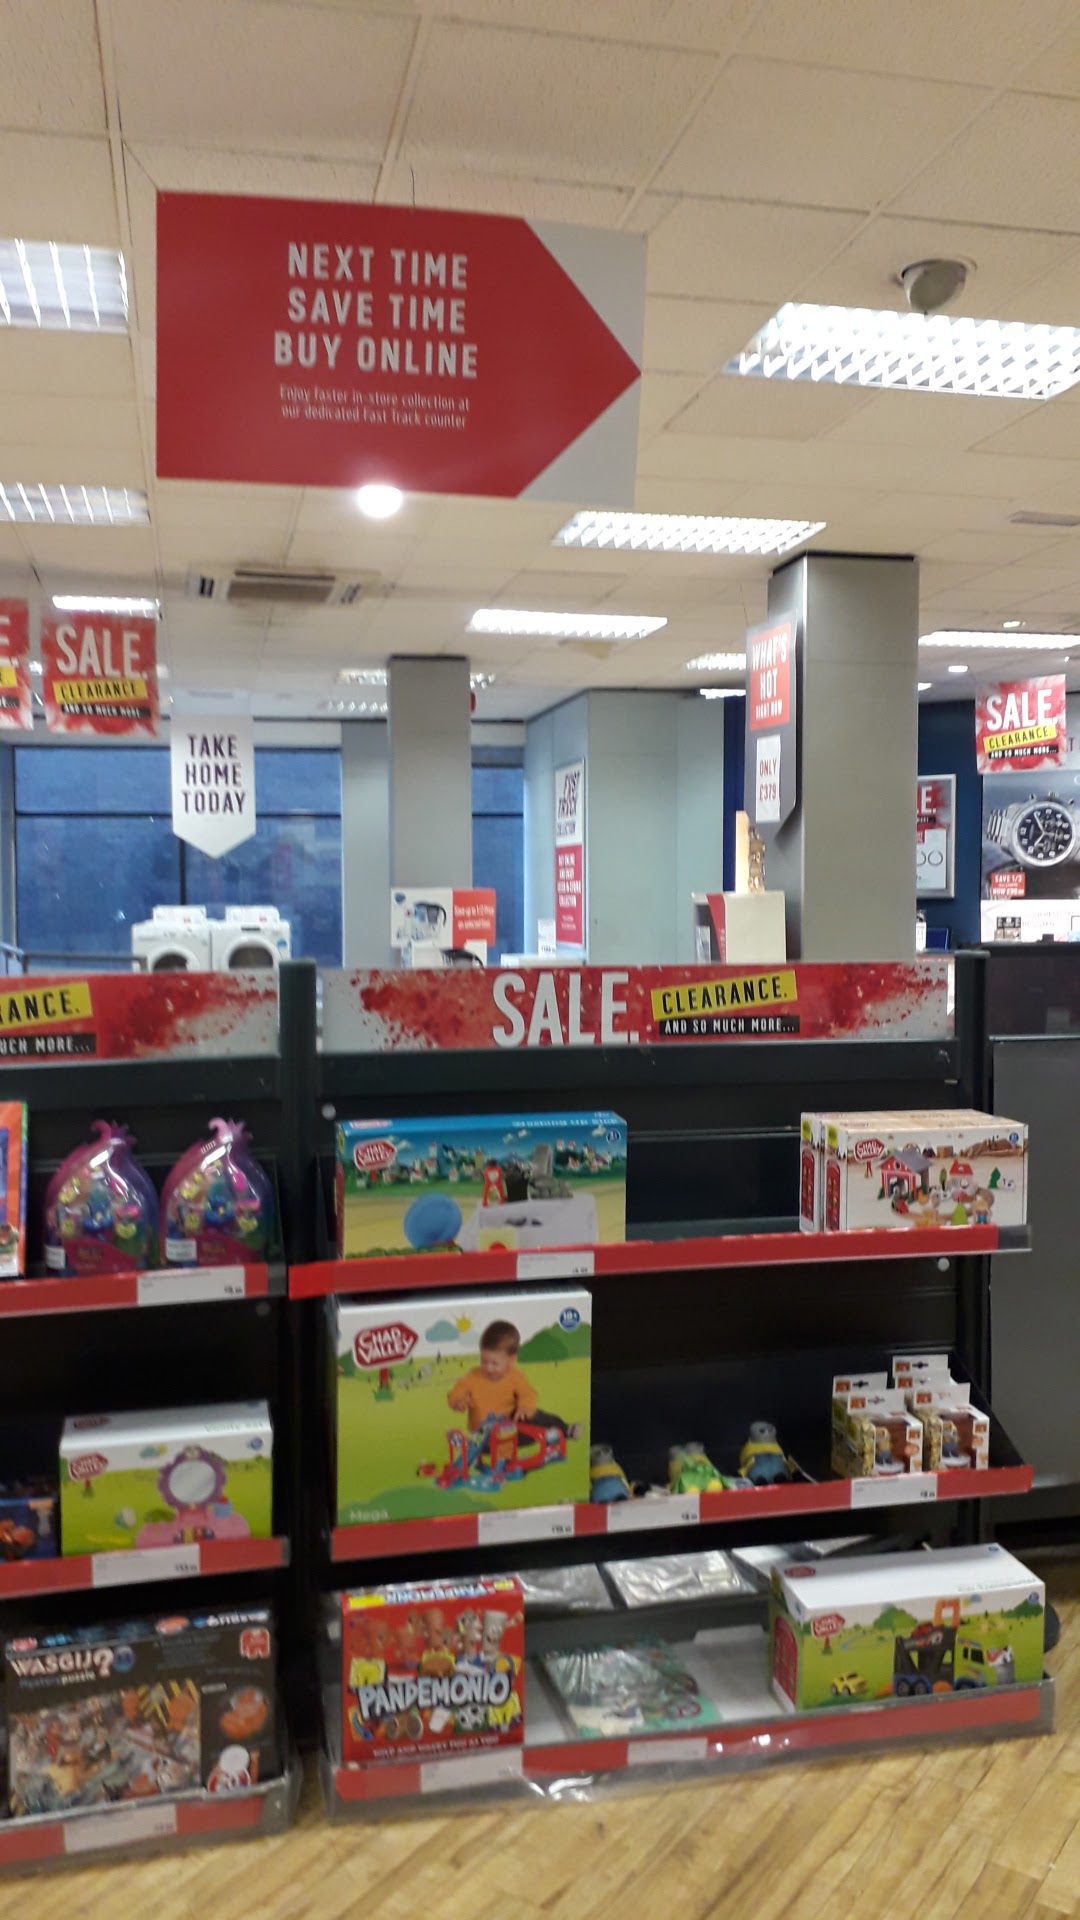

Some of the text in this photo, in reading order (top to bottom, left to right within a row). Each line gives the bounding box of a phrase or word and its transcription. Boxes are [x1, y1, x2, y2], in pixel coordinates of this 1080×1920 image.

[288, 241, 468, 291] NEXT TIME
[287, 286, 466, 334] SAVE TIME
[274, 330, 478, 379] BUY ONLINE
[280, 384, 310, 403] Enjoy
[314, 387, 348, 402] faster
[402, 392, 455, 410] collection
[458, 397, 470, 411] at
[282, 406, 300, 419] our
[305, 404, 360, 423] dedicated
[425, 413, 466, 429] counter
[752, 631, 788, 671] WHAT'S
[760, 668, 778, 701] HOT
[771, 699, 783, 718] NOW
[187, 734, 238, 759] TAKE
[990, 750, 1003, 759] AND
[1004, 749, 1013, 758] SO
[1014, 747, 1032, 757] MUCH
[185, 762, 242, 787] HOME
[759, 759, 777, 777] ONLY
[182, 790, 246, 815] TODAY
[759, 783, 777, 803] £379
[492, 971, 640, 1048] SALE.
[664, 1019, 688, 1036] AND
[692, 1019, 707, 1035] SO
[713, 1018, 746, 1034] MUCH
[358, 1335, 415, 1364] VALLEY
[357, 1672, 512, 1721] PANDEMONIO
